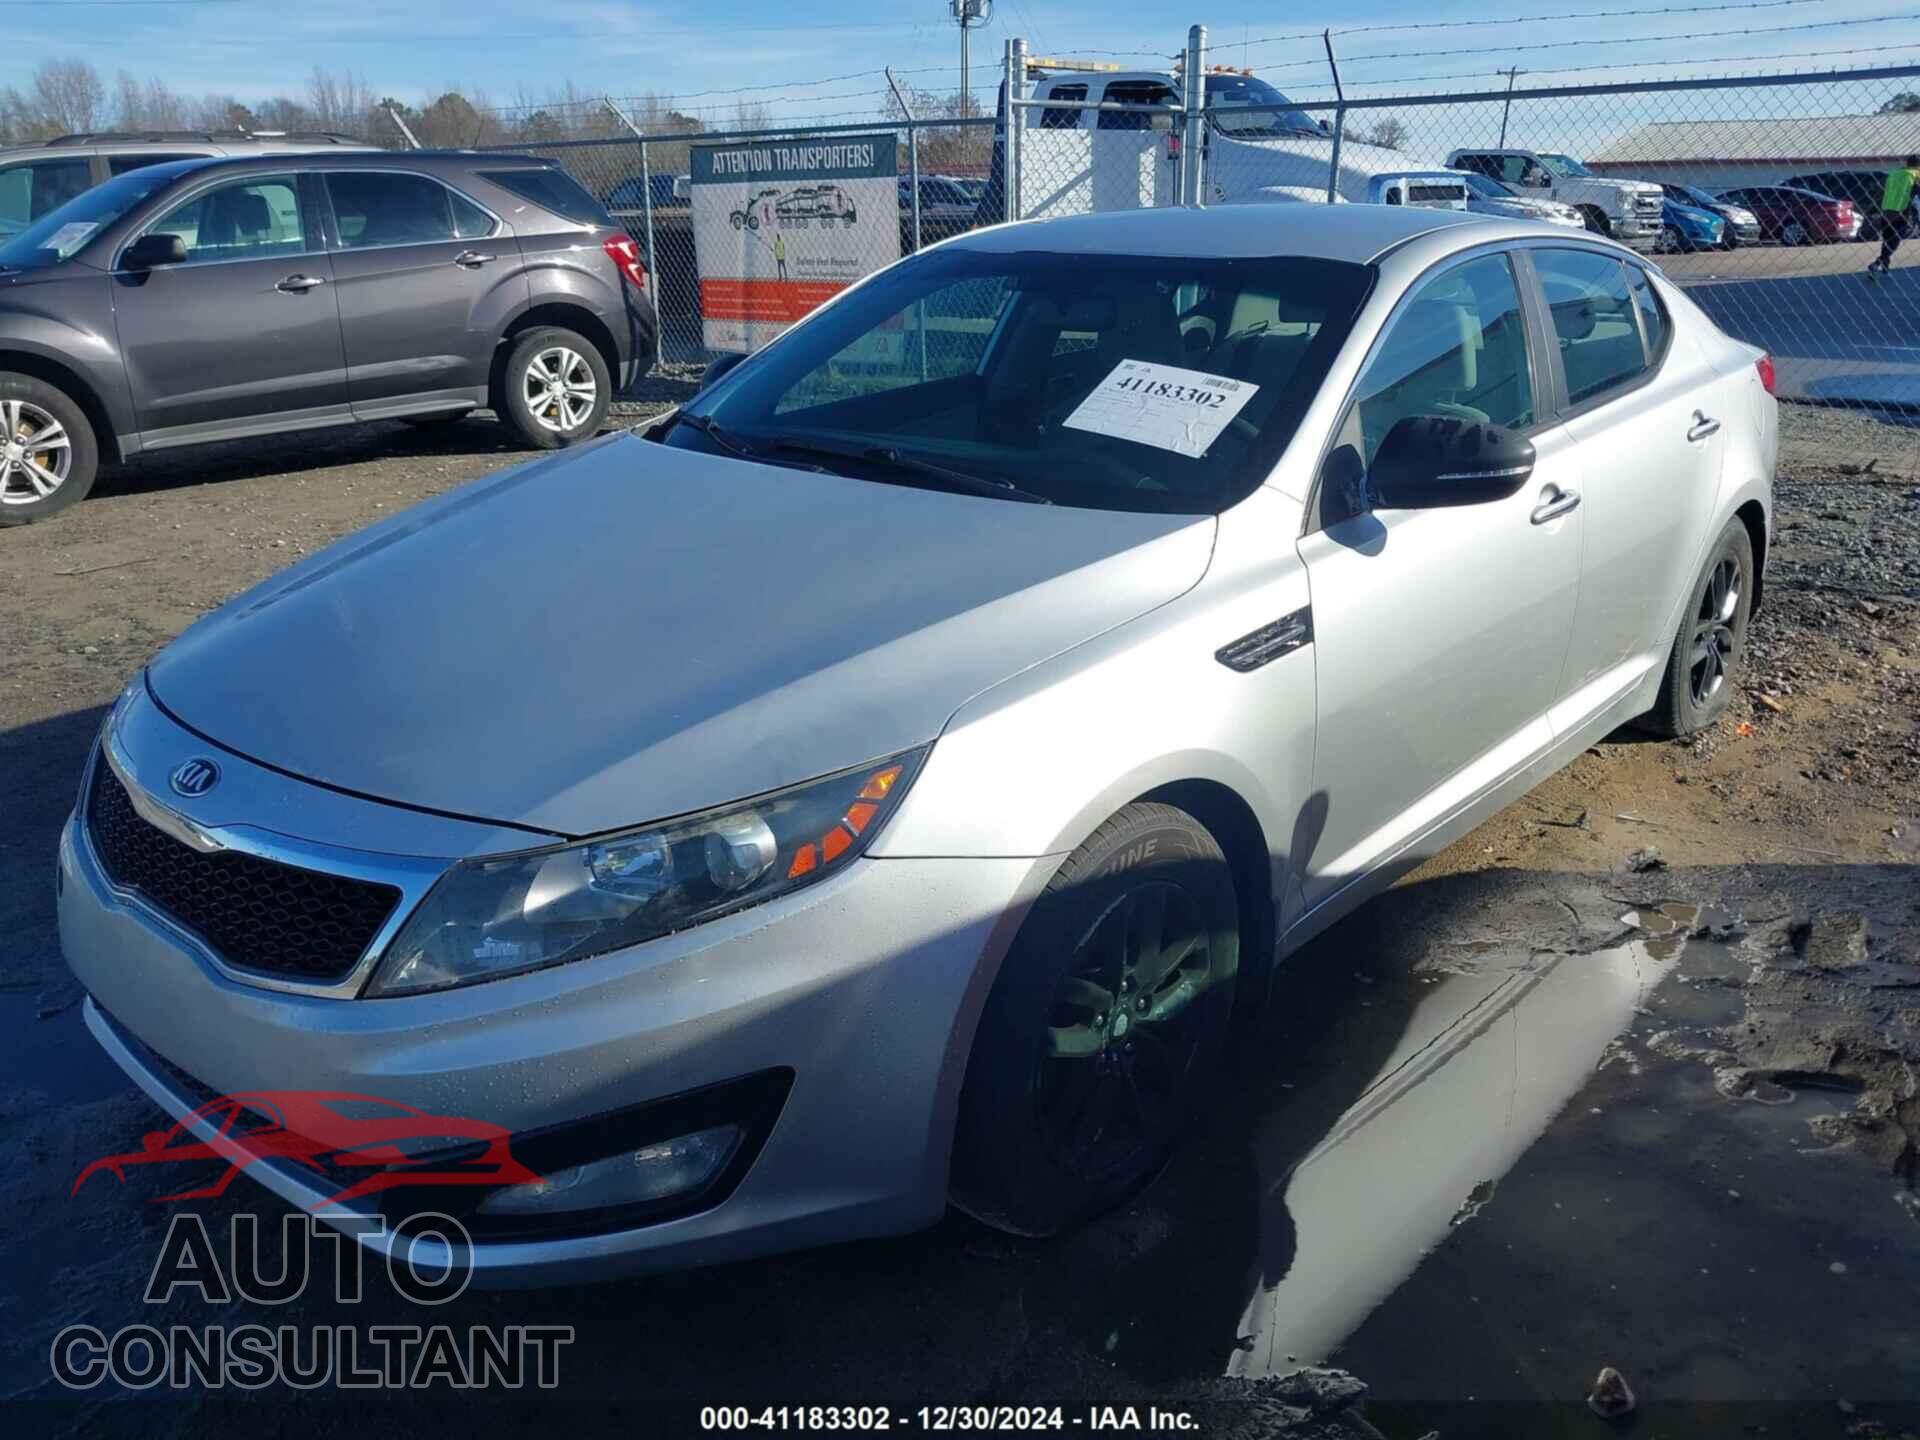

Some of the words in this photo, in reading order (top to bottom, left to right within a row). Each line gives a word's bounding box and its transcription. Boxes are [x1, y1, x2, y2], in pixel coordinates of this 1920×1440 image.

[712, 149, 773, 175] ATTENTION
[773, 143, 875, 171] TRANSPORTERS!
[1116, 376, 1226, 409] 41183302
